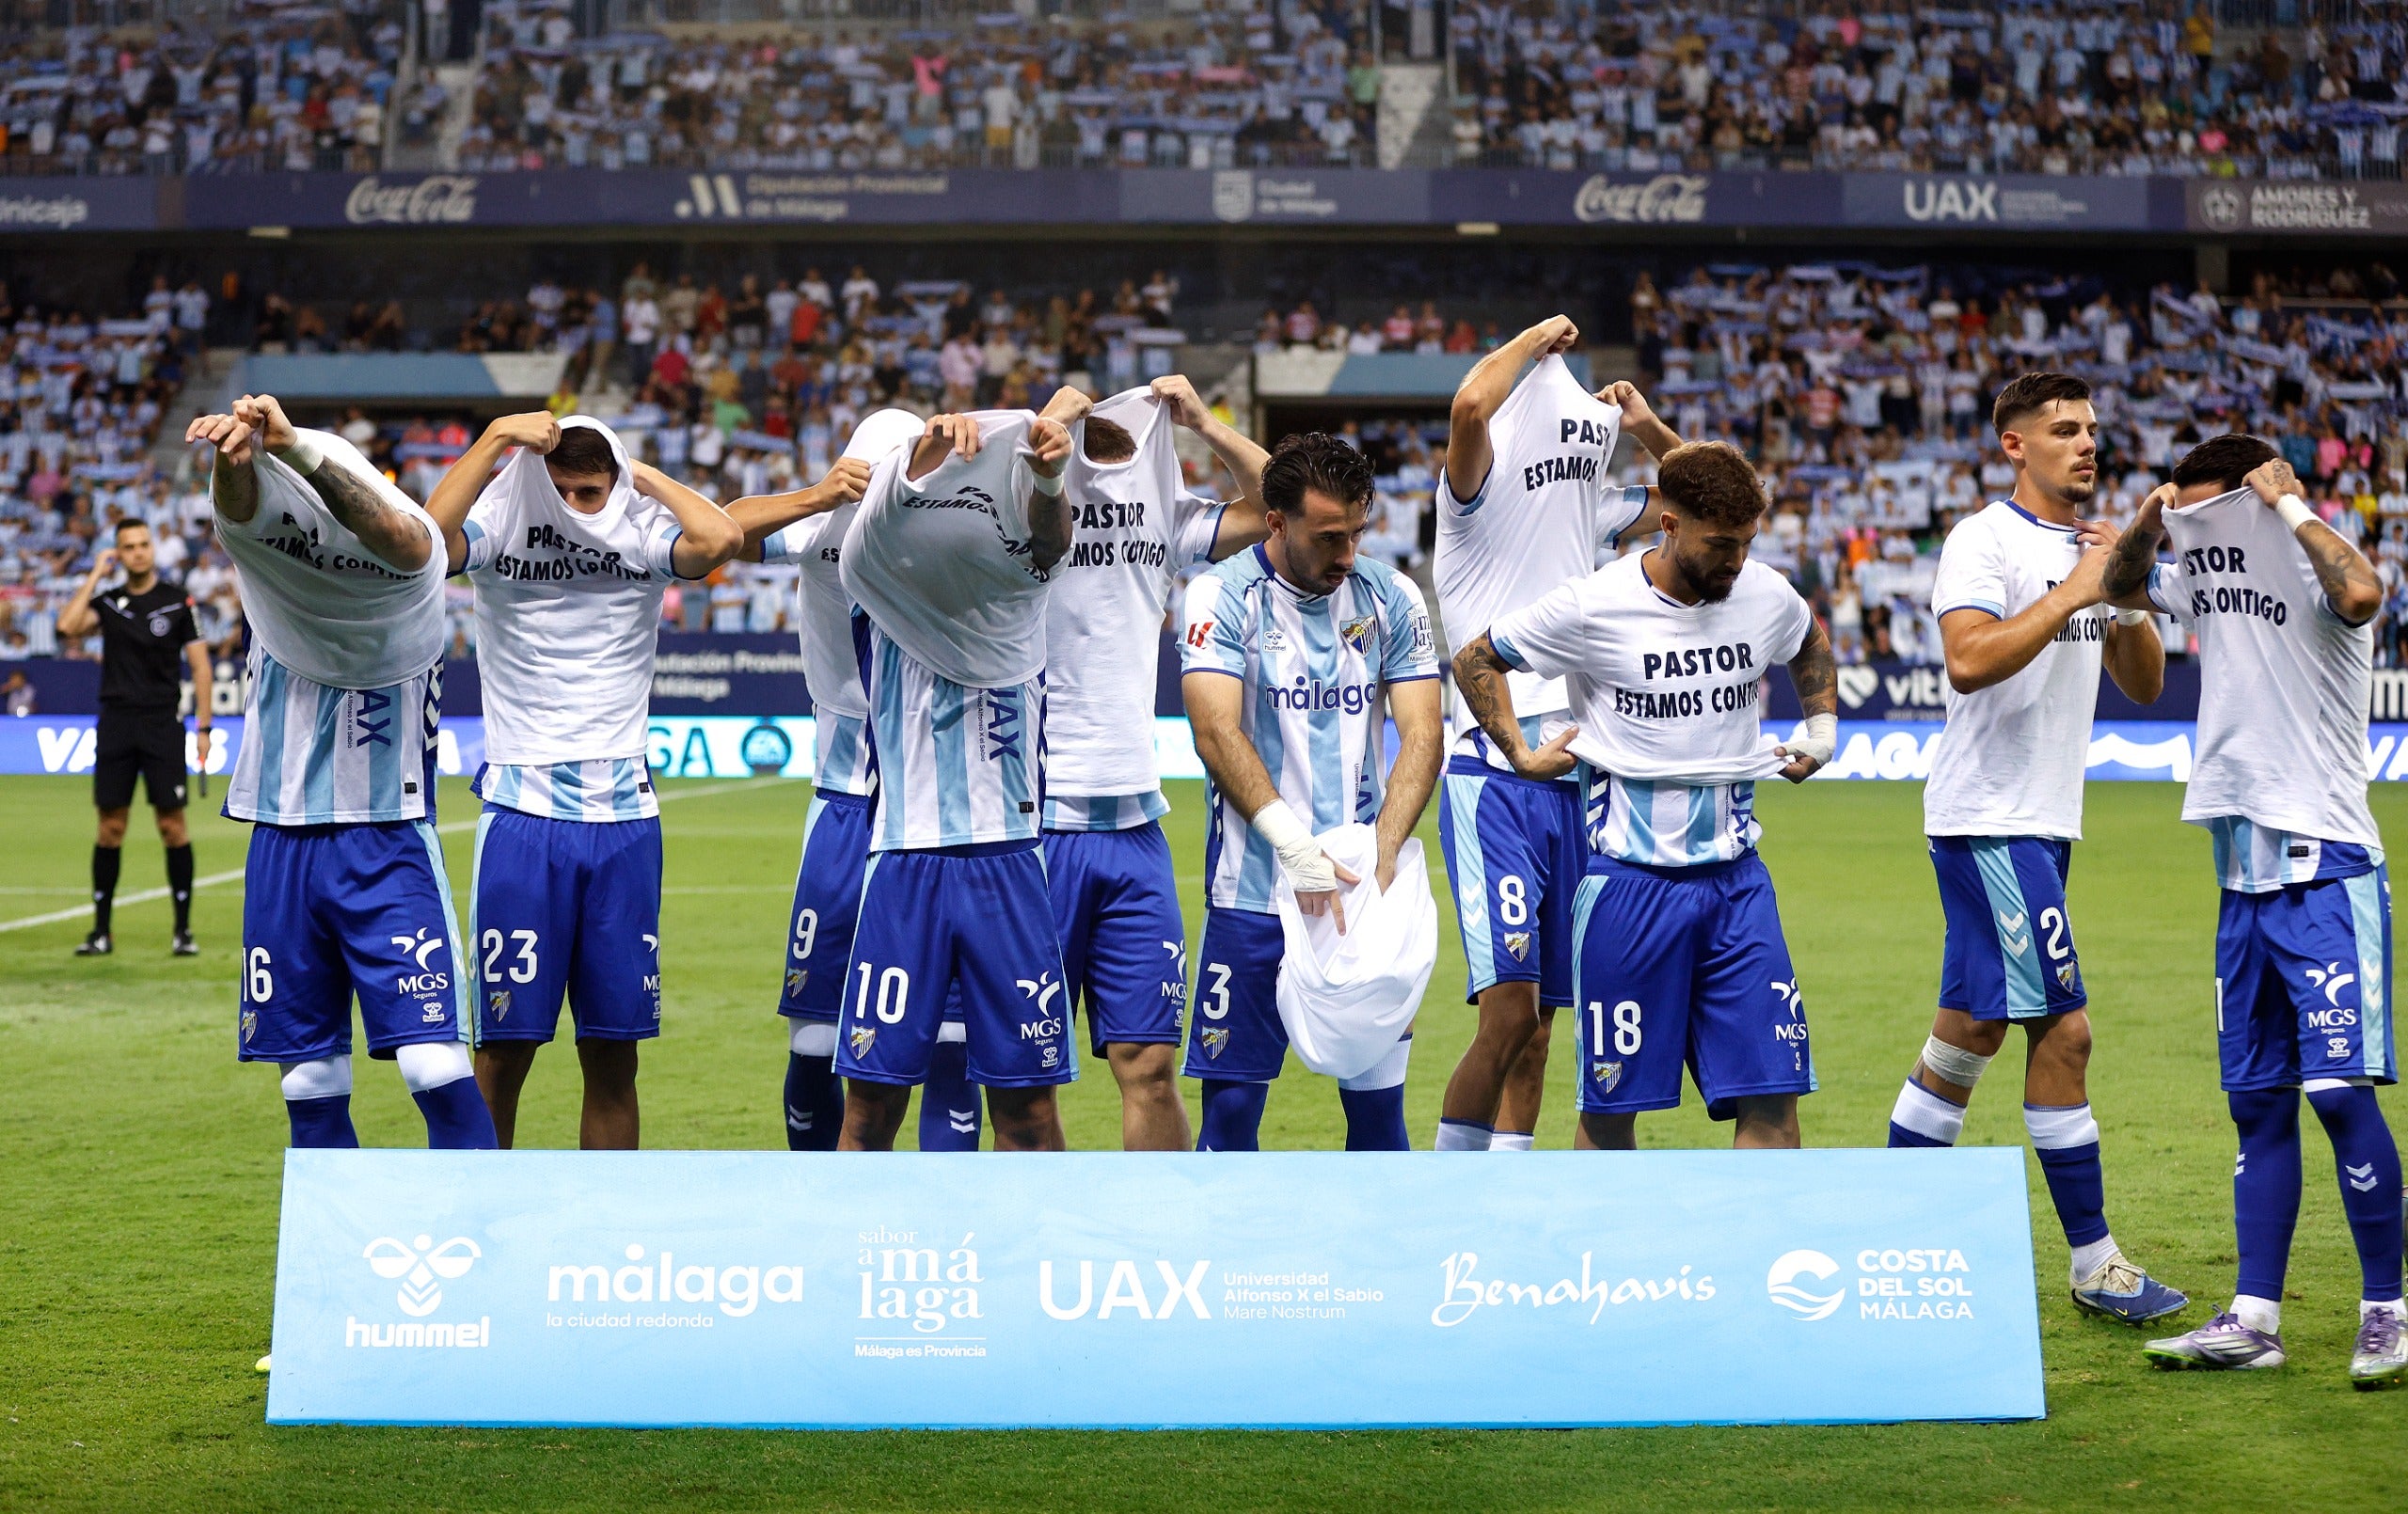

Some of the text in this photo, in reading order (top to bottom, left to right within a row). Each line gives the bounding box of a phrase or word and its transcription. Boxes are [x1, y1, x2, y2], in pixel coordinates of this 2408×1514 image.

[1903, 180, 1998, 222] UAX
[1069, 541, 1115, 568] MOS
[2184, 545, 2246, 577] STOR
[1643, 642, 1753, 680] PASTOR
[1614, 687, 1703, 718] ESTAMOS
[1497, 875, 1529, 925] 8
[792, 907, 818, 960] 9
[2040, 907, 2076, 960] 2
[483, 929, 538, 984] 23
[398, 972, 449, 994] MGS
[412, 992, 438, 1001] Seguros
[855, 961, 910, 1024] 10
[1202, 962, 1232, 1020] 3
[1021, 1017, 1061, 1040] MGS
[1589, 1001, 1641, 1056] 18
[2307, 1008, 2357, 1029] MGS
[858, 1224, 919, 1244] sabor
[1857, 1249, 1971, 1272] COSTA
[1039, 1260, 1212, 1321] UAX
[1224, 1271, 1329, 1286] Universidad
[1859, 1277, 1972, 1297] DEL SOL
[1224, 1287, 1384, 1302] Alfonso X el Sabio
[547, 1313, 713, 1328] la ciudad redonda
[1224, 1305, 1346, 1319] Mare Nostrum
[1861, 1298, 1973, 1320] MÁLAGA
[345, 1317, 490, 1348] hummel
[855, 1344, 987, 1360] Málaga es Provincia
